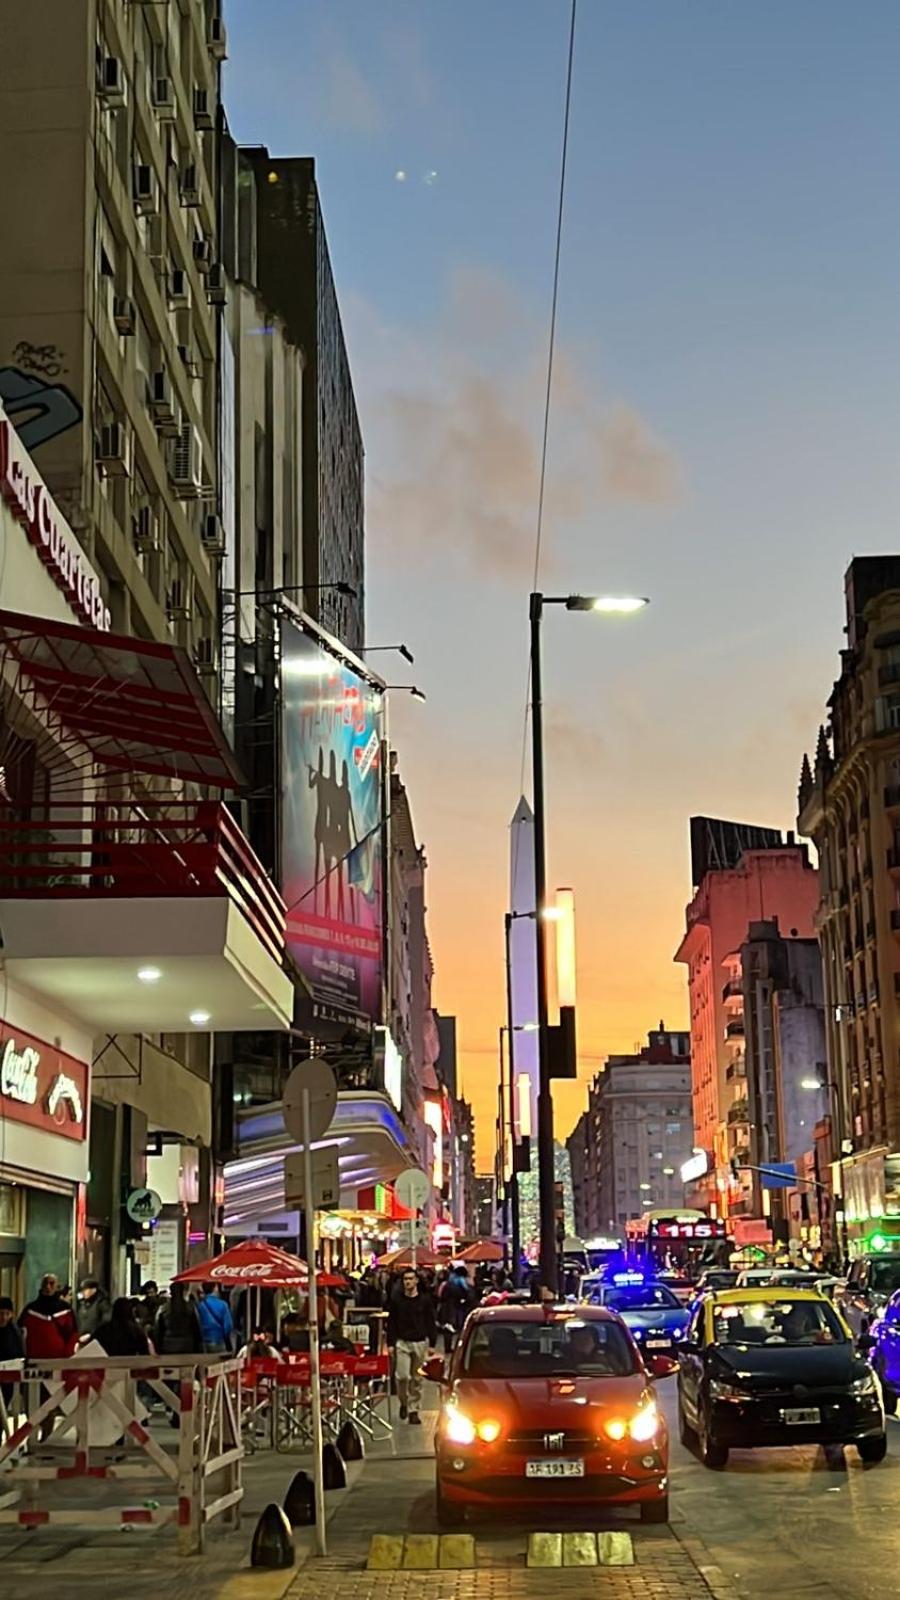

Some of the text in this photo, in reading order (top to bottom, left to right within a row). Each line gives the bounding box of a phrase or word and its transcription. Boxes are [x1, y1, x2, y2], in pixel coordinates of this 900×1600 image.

[6, 421, 111, 632] Las Cuartetas
[665, 1225, 712, 1237] 115
